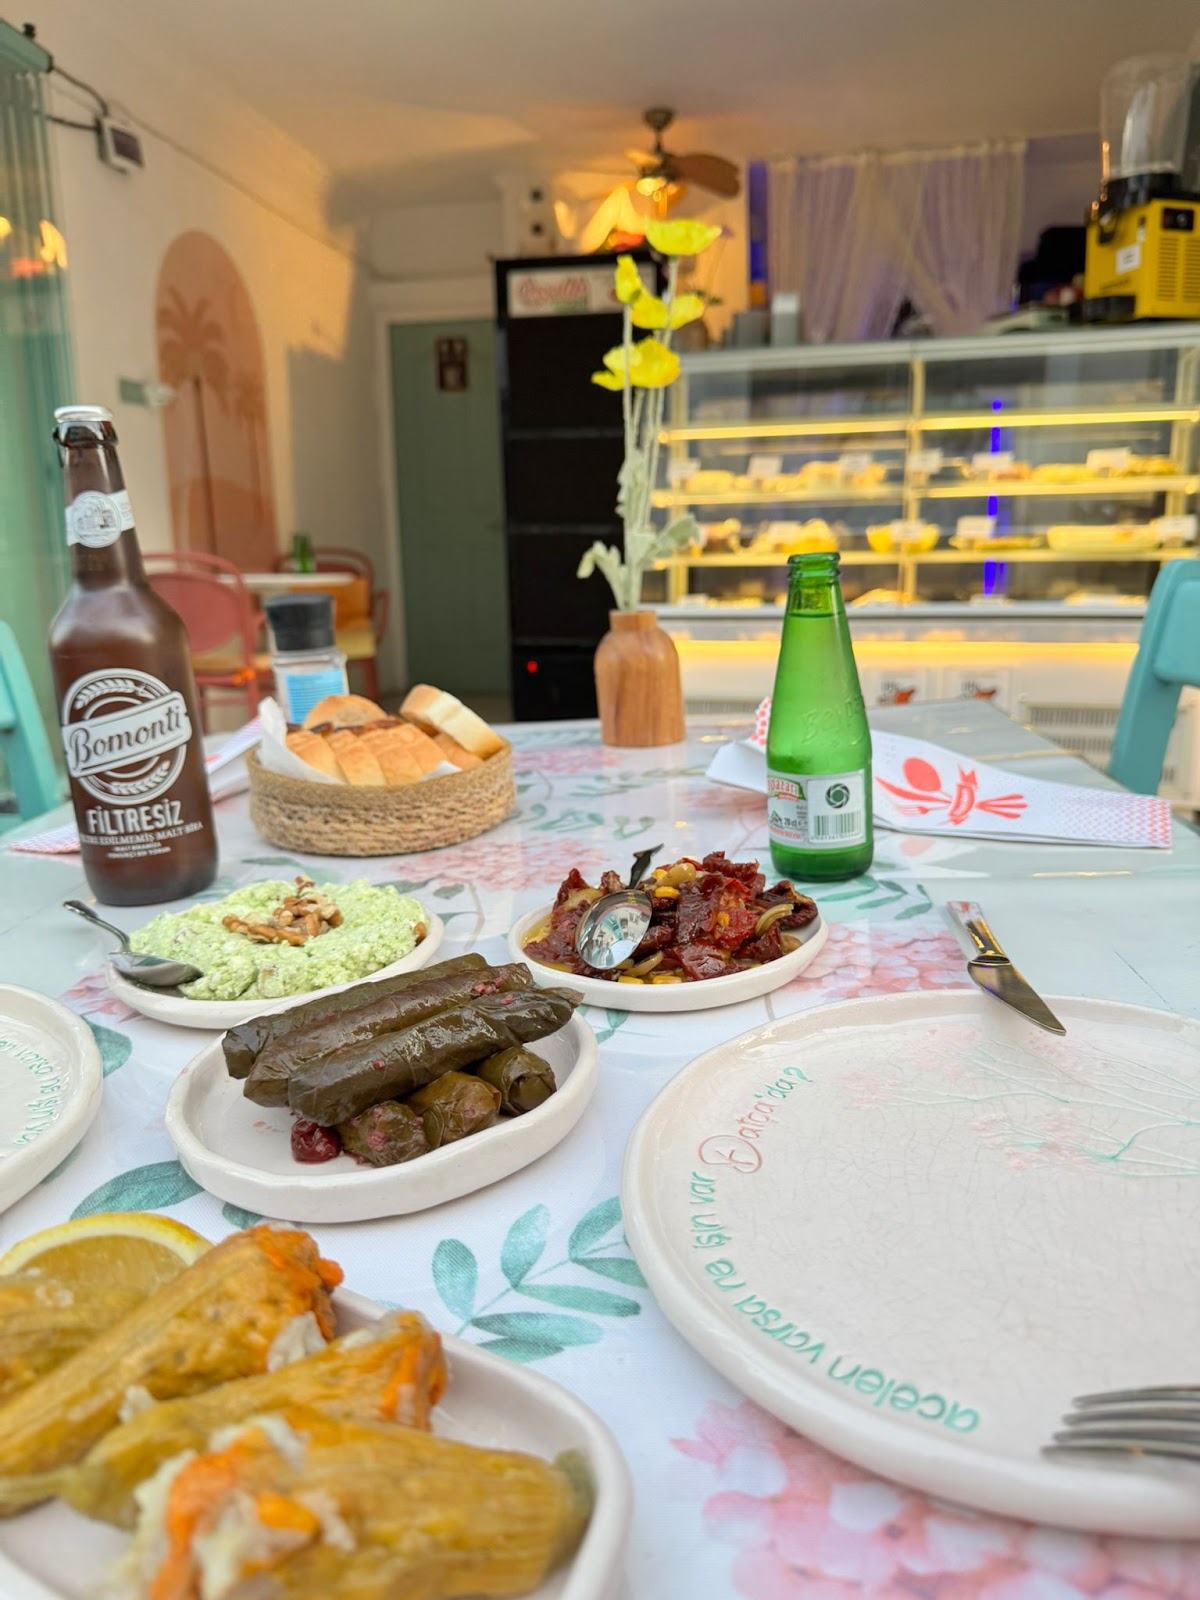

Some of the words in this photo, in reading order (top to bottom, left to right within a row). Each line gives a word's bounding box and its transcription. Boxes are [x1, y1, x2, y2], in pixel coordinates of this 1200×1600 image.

[69, 705, 181, 772] Bomonti
[87, 799, 184, 835] FİLTRESİZ
[156, 827, 183, 841] MALT
[698, 1066, 813, 1174] Datça'da?
[690, 1171, 717, 1205] var
[690, 1213, 732, 1249] işin
[705, 1258, 746, 1292] ne
[734, 1294, 826, 1364] varsa
[827, 1355, 981, 1434] acelen
